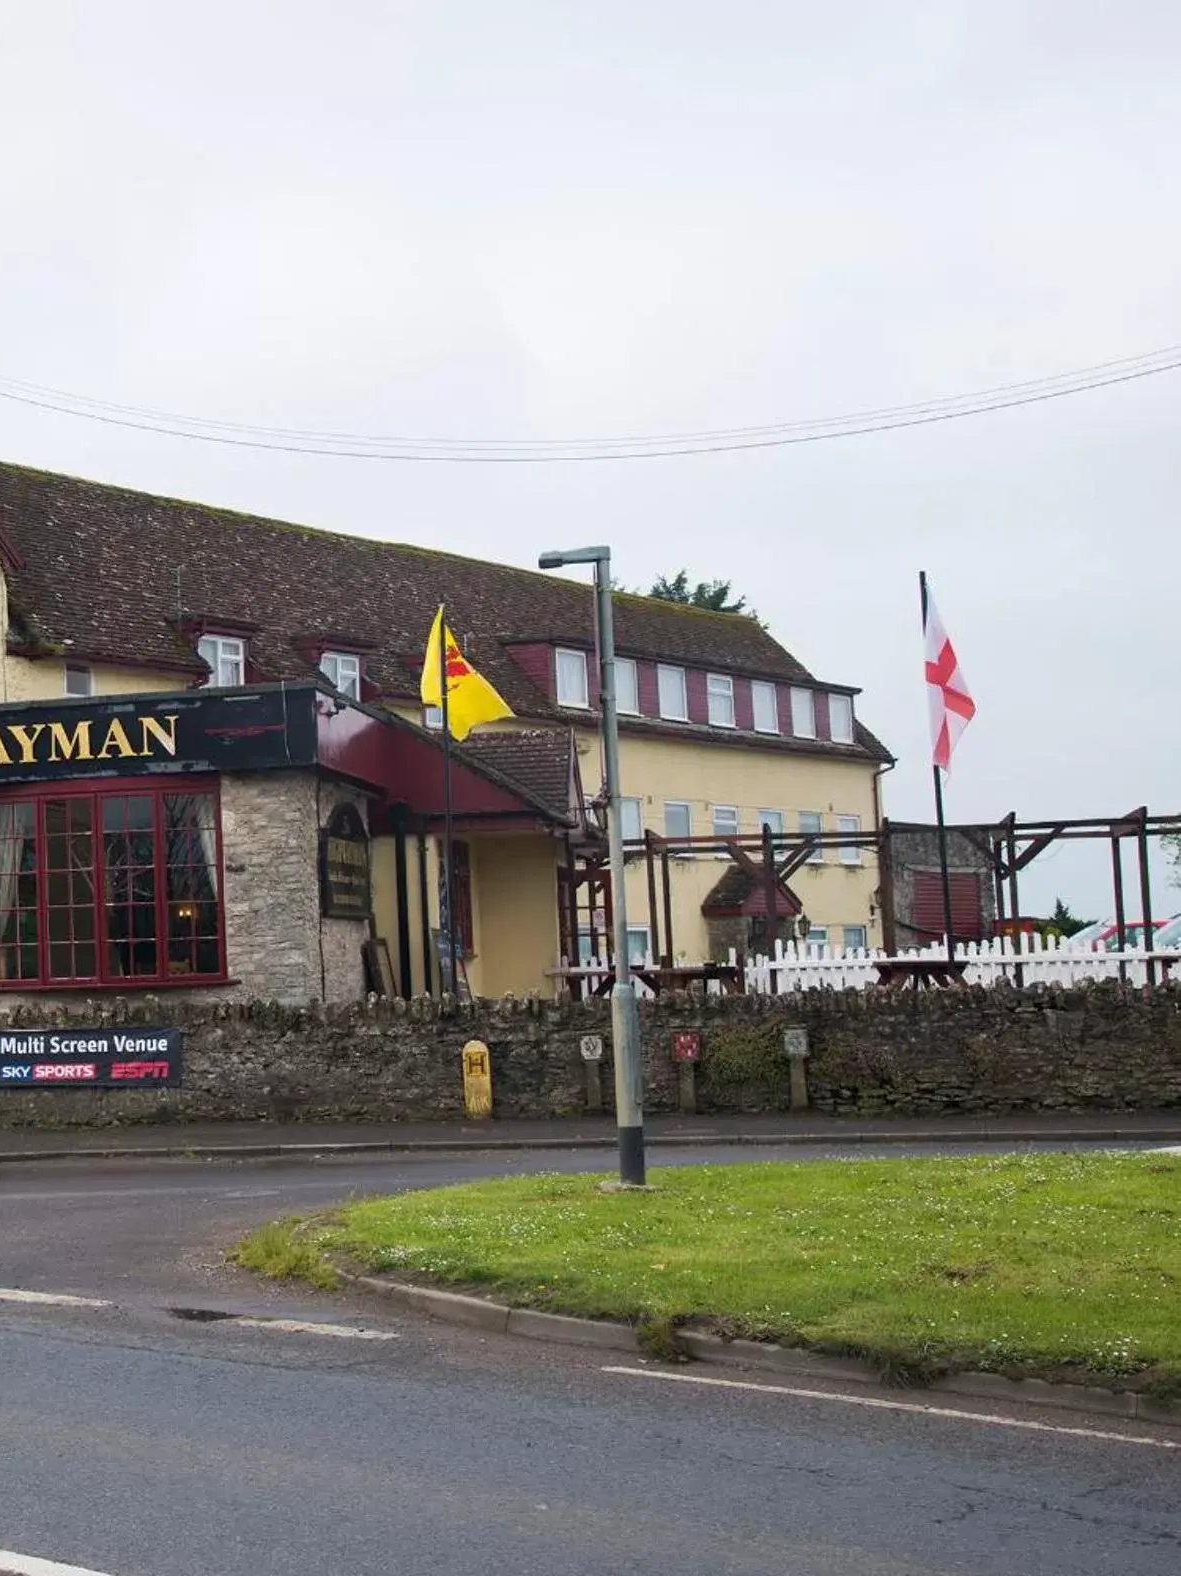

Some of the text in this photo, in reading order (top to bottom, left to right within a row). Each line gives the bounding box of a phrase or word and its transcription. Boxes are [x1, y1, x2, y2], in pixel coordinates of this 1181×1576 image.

[0, 1035, 168, 1055] Multi Screen Venue
[2, 1063, 95, 1079] SKY SPORTS
[111, 1062, 169, 1079] ESPN
[468, 1055, 485, 1074] H
